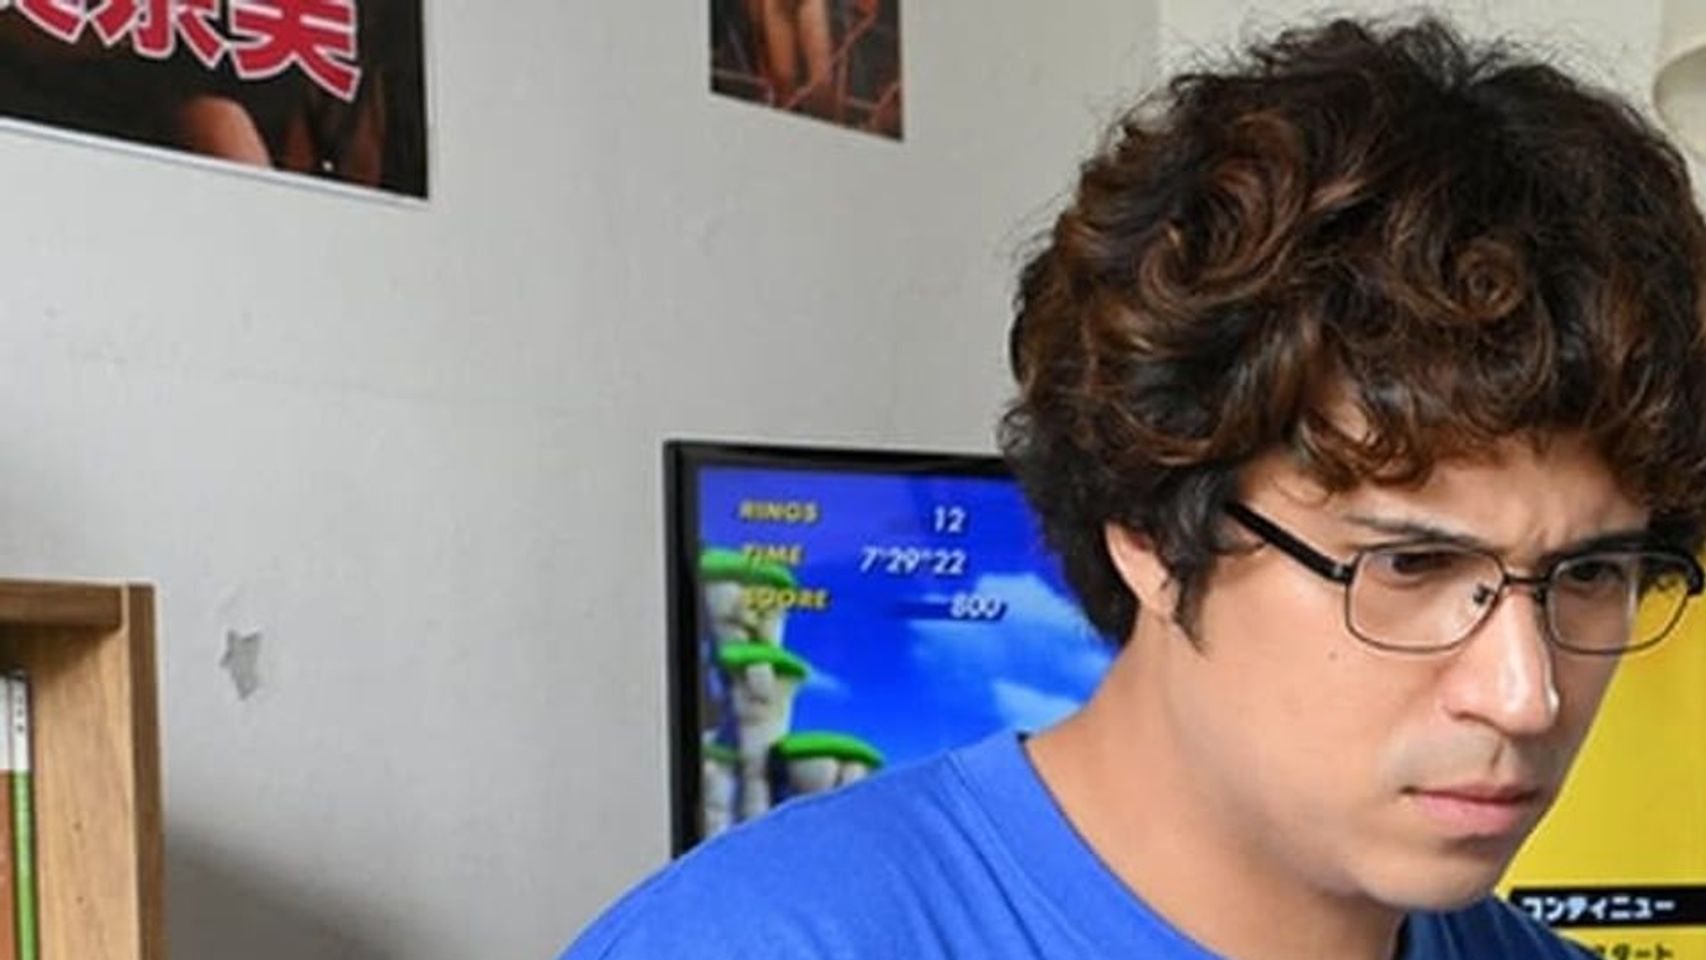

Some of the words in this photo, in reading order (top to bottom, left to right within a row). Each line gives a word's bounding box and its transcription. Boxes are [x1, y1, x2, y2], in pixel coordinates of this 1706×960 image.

[739, 500, 818, 523] RINGS
[934, 505, 966, 533] 12
[743, 543, 802, 567] TIME
[950, 593, 1002, 619] 800
[1522, 896, 1676, 920] コンティニュー
